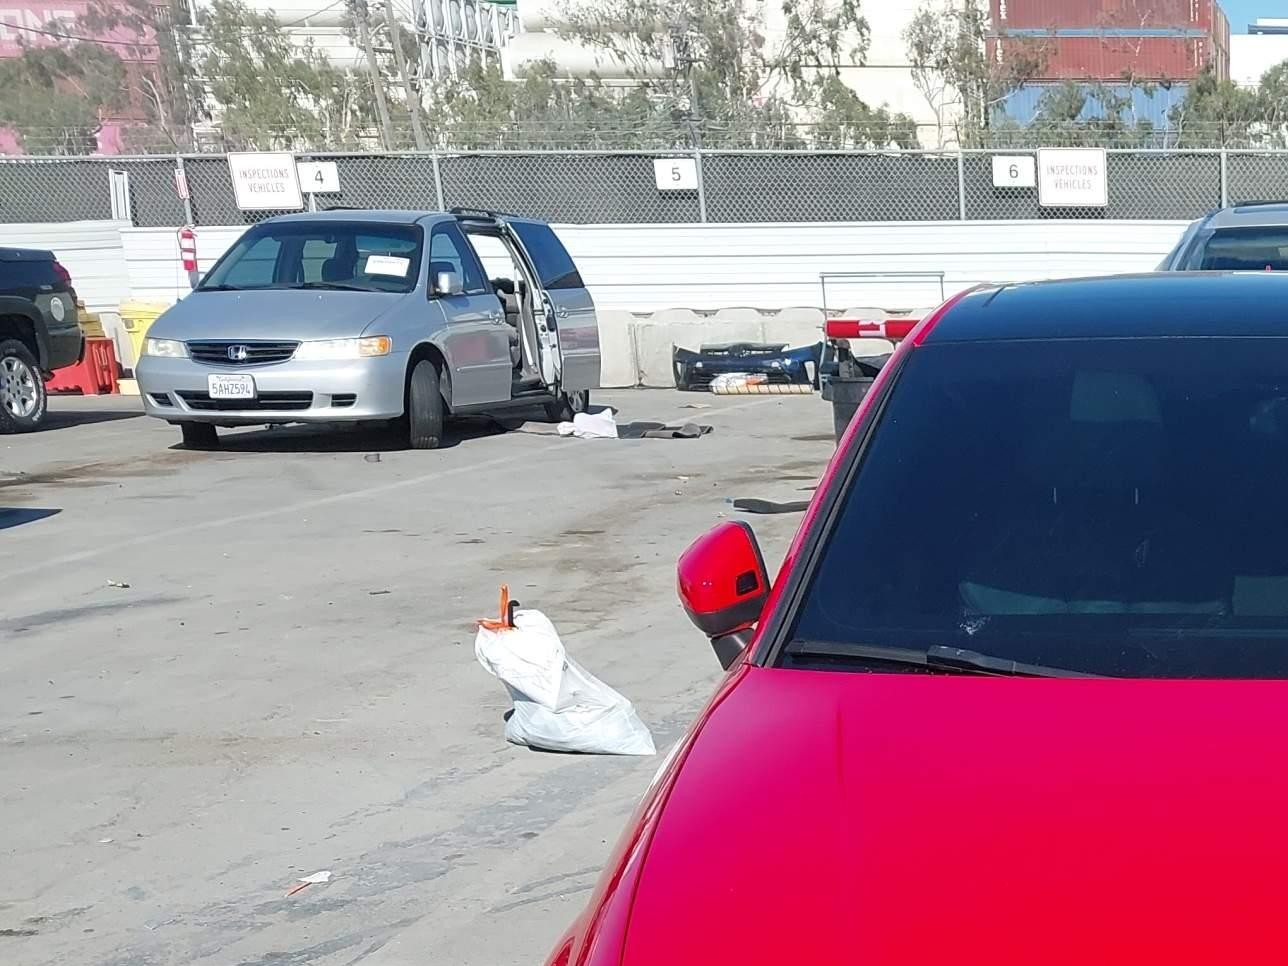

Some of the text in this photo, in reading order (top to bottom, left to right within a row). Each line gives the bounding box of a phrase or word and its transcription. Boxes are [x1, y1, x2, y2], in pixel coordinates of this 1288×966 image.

[239, 168, 289, 179] INSPECTIONS
[671, 167, 681, 181] 5
[1009, 164, 1019, 178] 6
[1046, 165, 1098, 176] INSPECTIONS
[314, 169, 324, 185] 4
[248, 182, 285, 193] VEHICLES
[1053, 179, 1092, 190] VEHICLES
